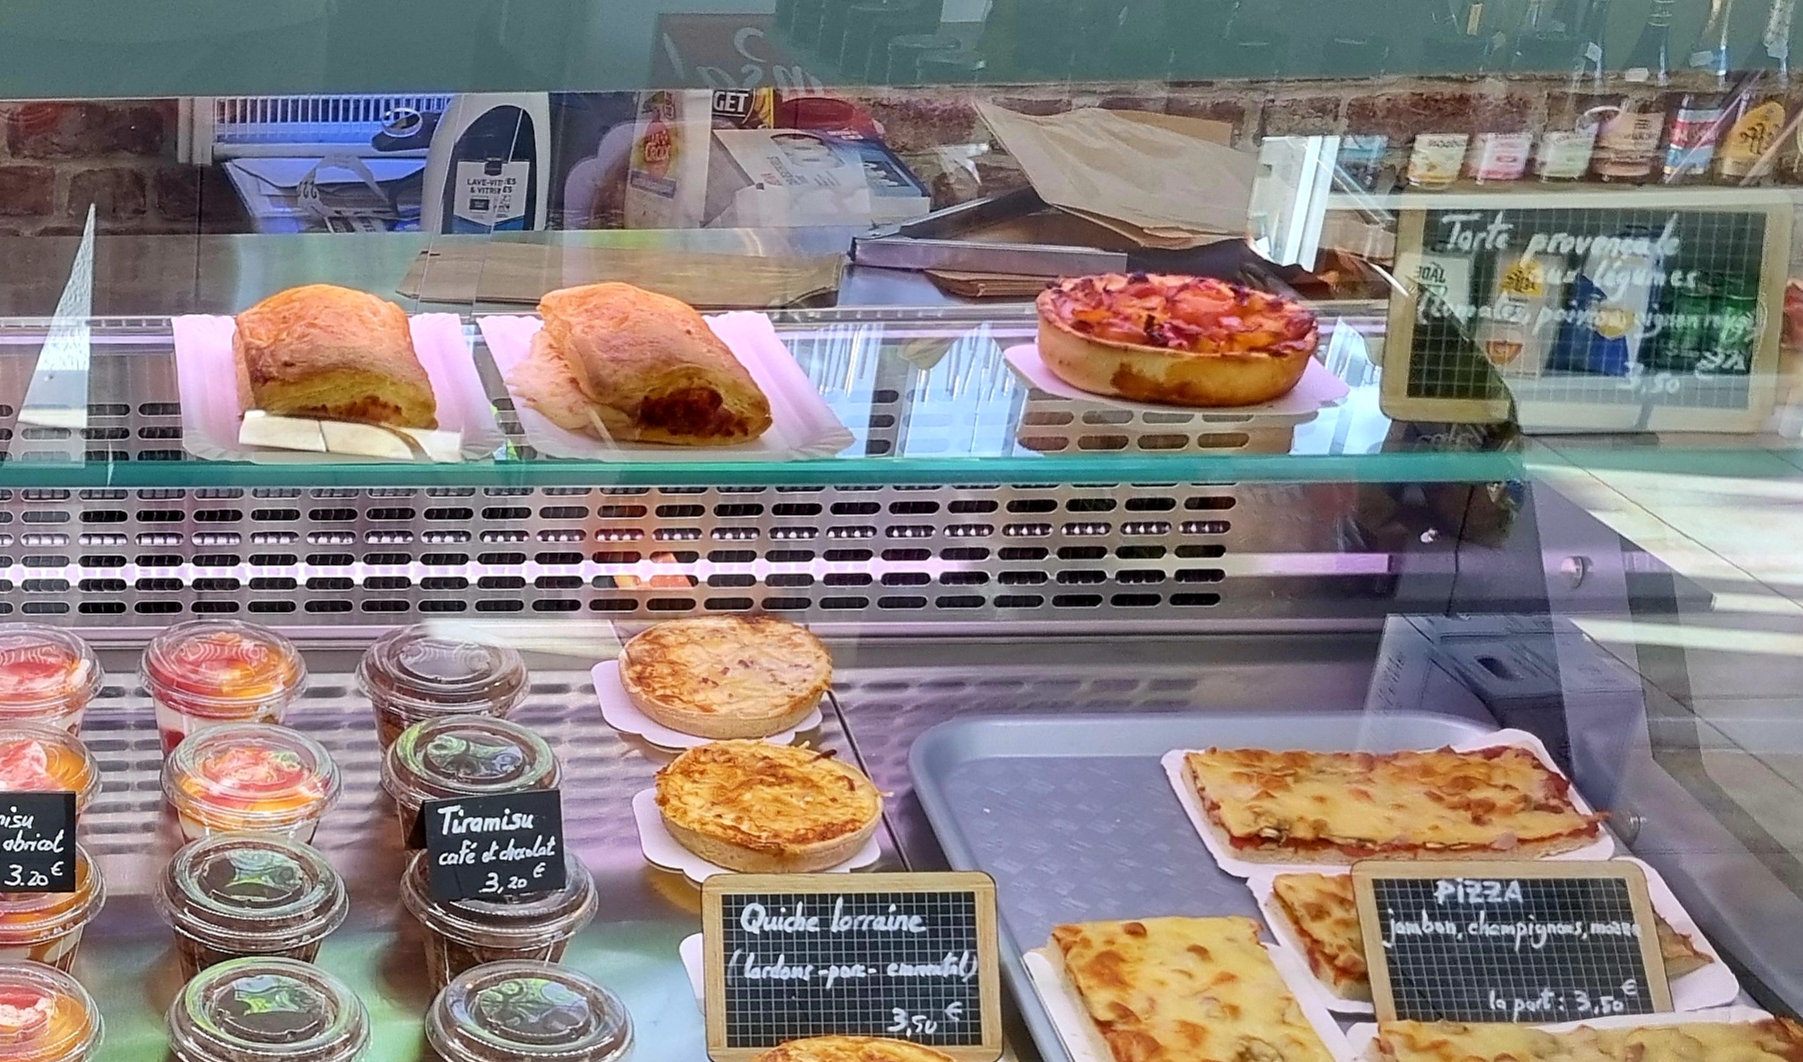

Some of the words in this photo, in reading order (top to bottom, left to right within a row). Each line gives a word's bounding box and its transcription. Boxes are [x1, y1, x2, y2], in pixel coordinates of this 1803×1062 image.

[466, 177, 517, 187] LAVE-VITES
[437, 804, 534, 835] Tiramisu
[438, 839, 478, 865] café
[740, 901, 820, 935] Quiche
[1488, 989, 1507, 1011] la
